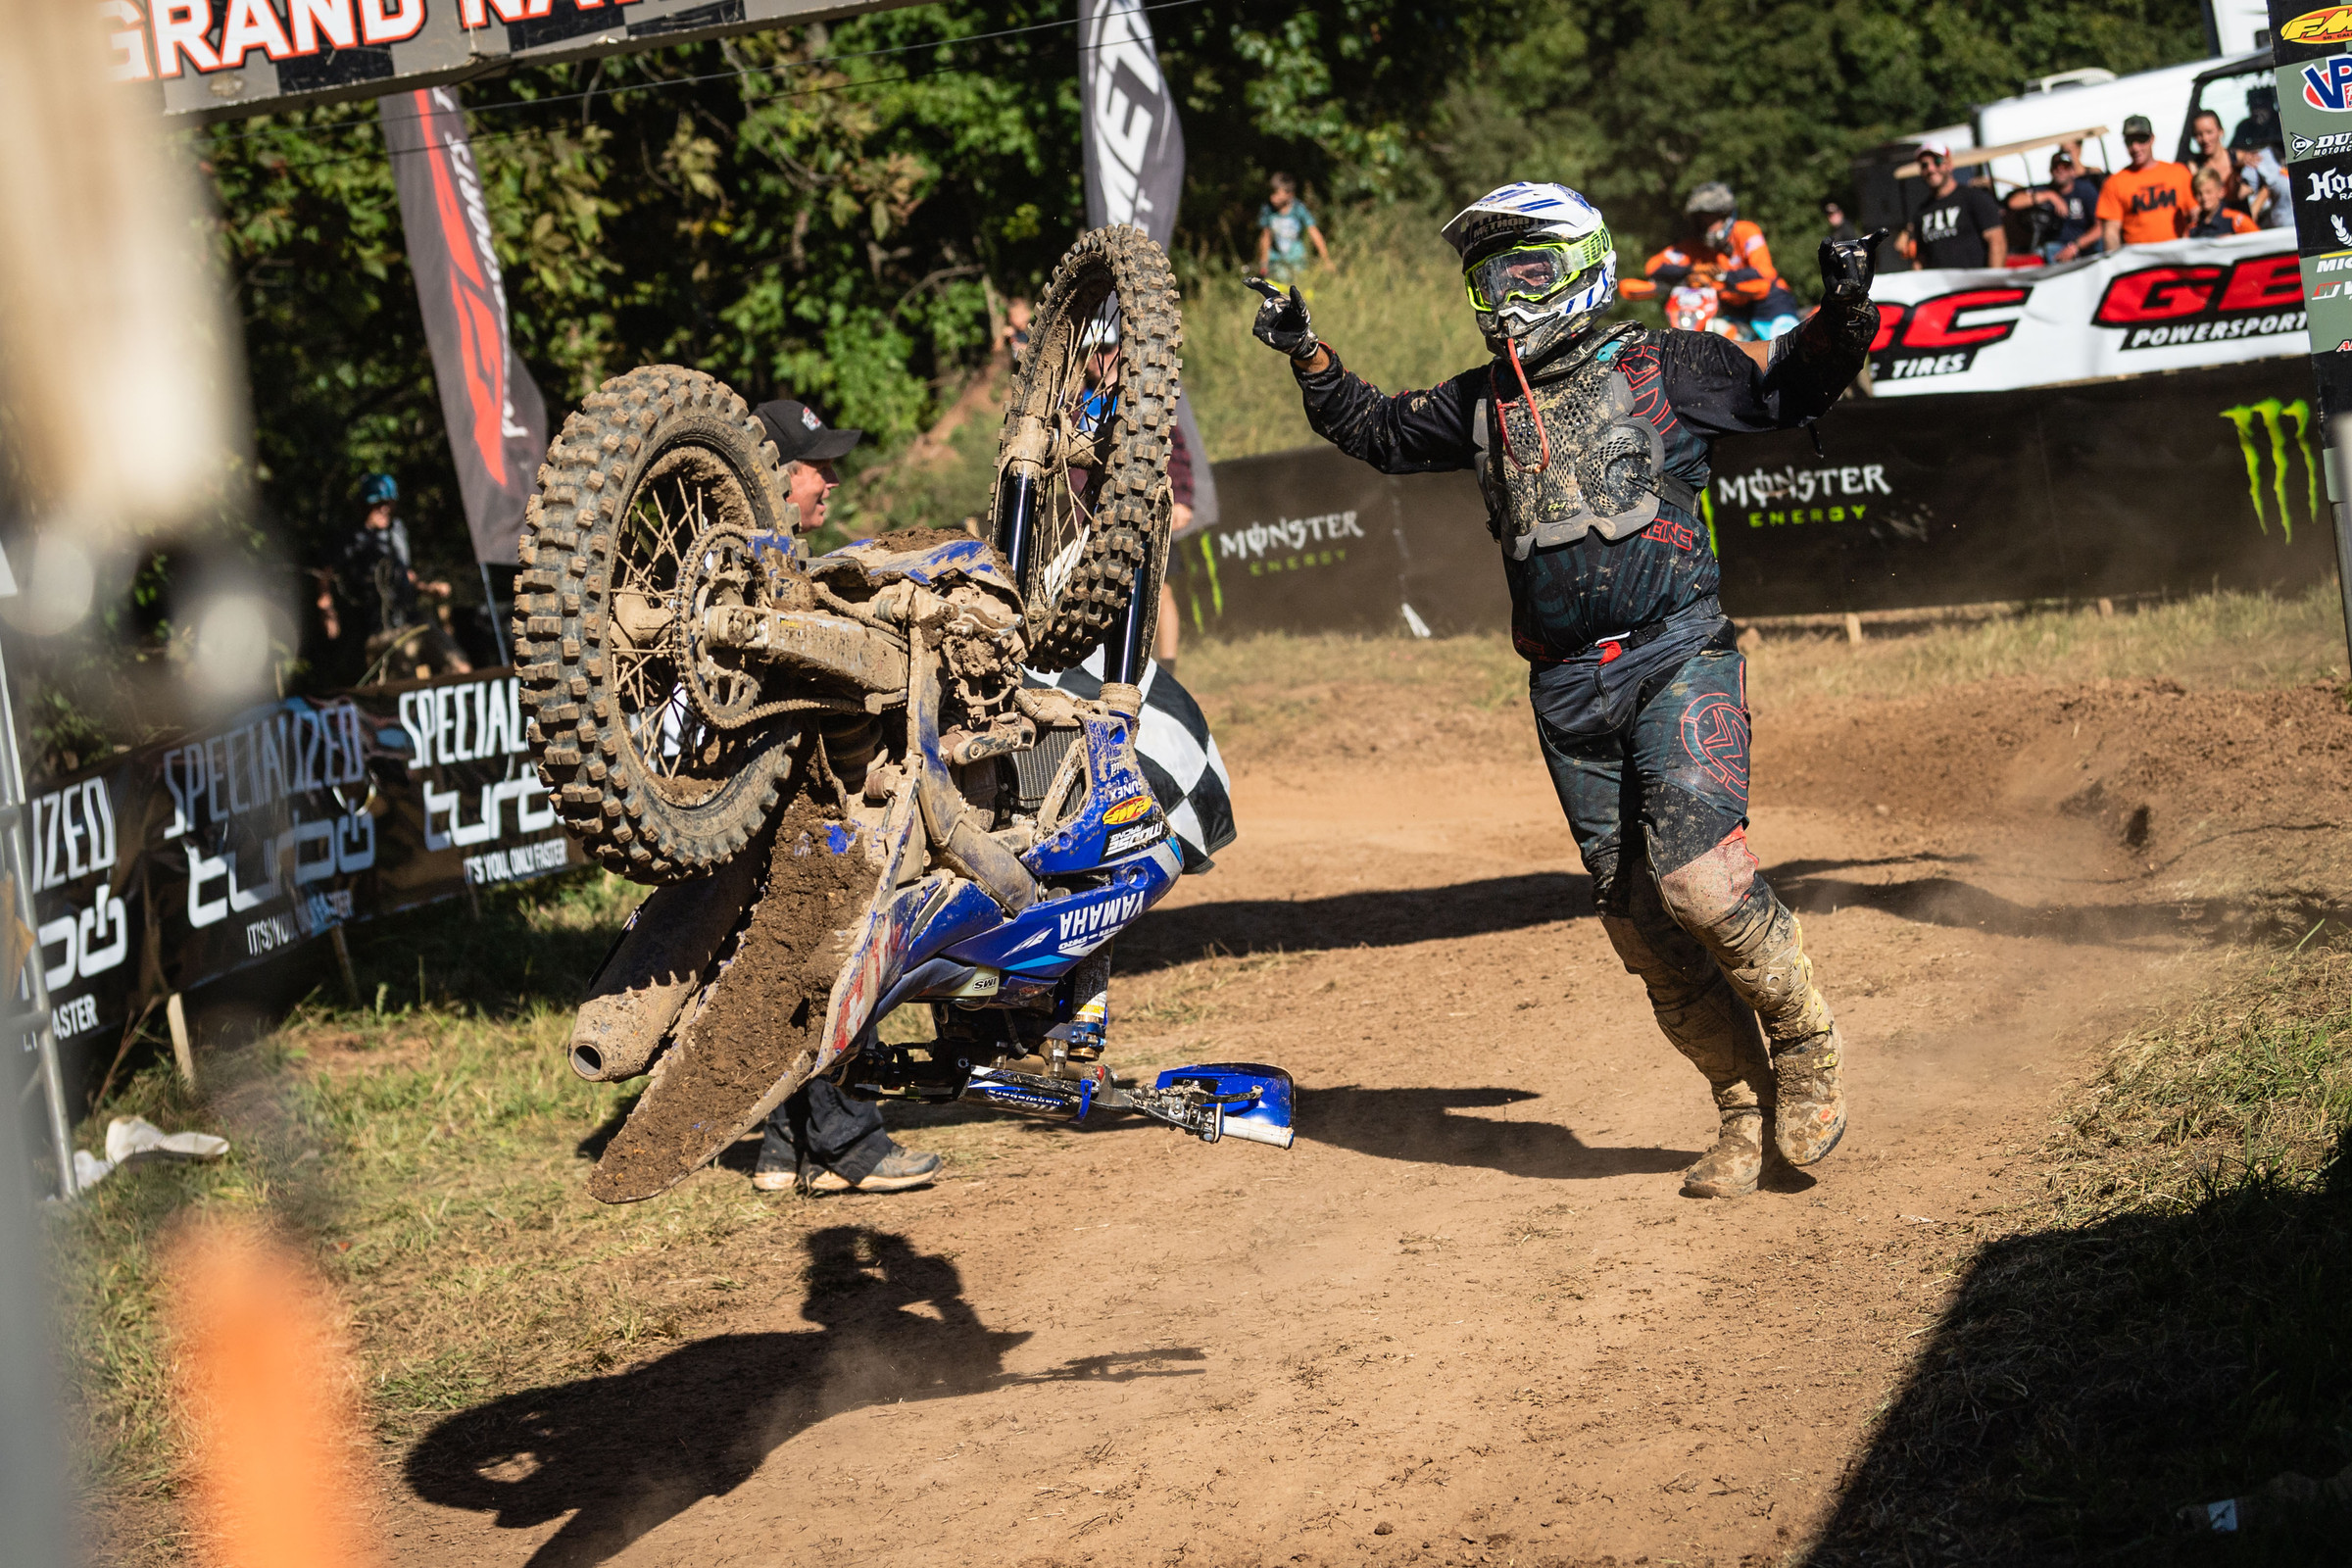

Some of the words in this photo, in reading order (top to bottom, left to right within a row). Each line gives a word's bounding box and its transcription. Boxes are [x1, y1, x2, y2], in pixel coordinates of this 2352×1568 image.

[2130, 186, 2177, 216] KTM
[1891, 353, 1967, 379] TIRES
[1717, 463, 1892, 509] MONSTER
[1219, 510, 1365, 560] MONSTER
[163, 704, 366, 841] SPECIALIZED
[1059, 891, 1146, 941] YAMAHA
[973, 976, 999, 991] IMS
